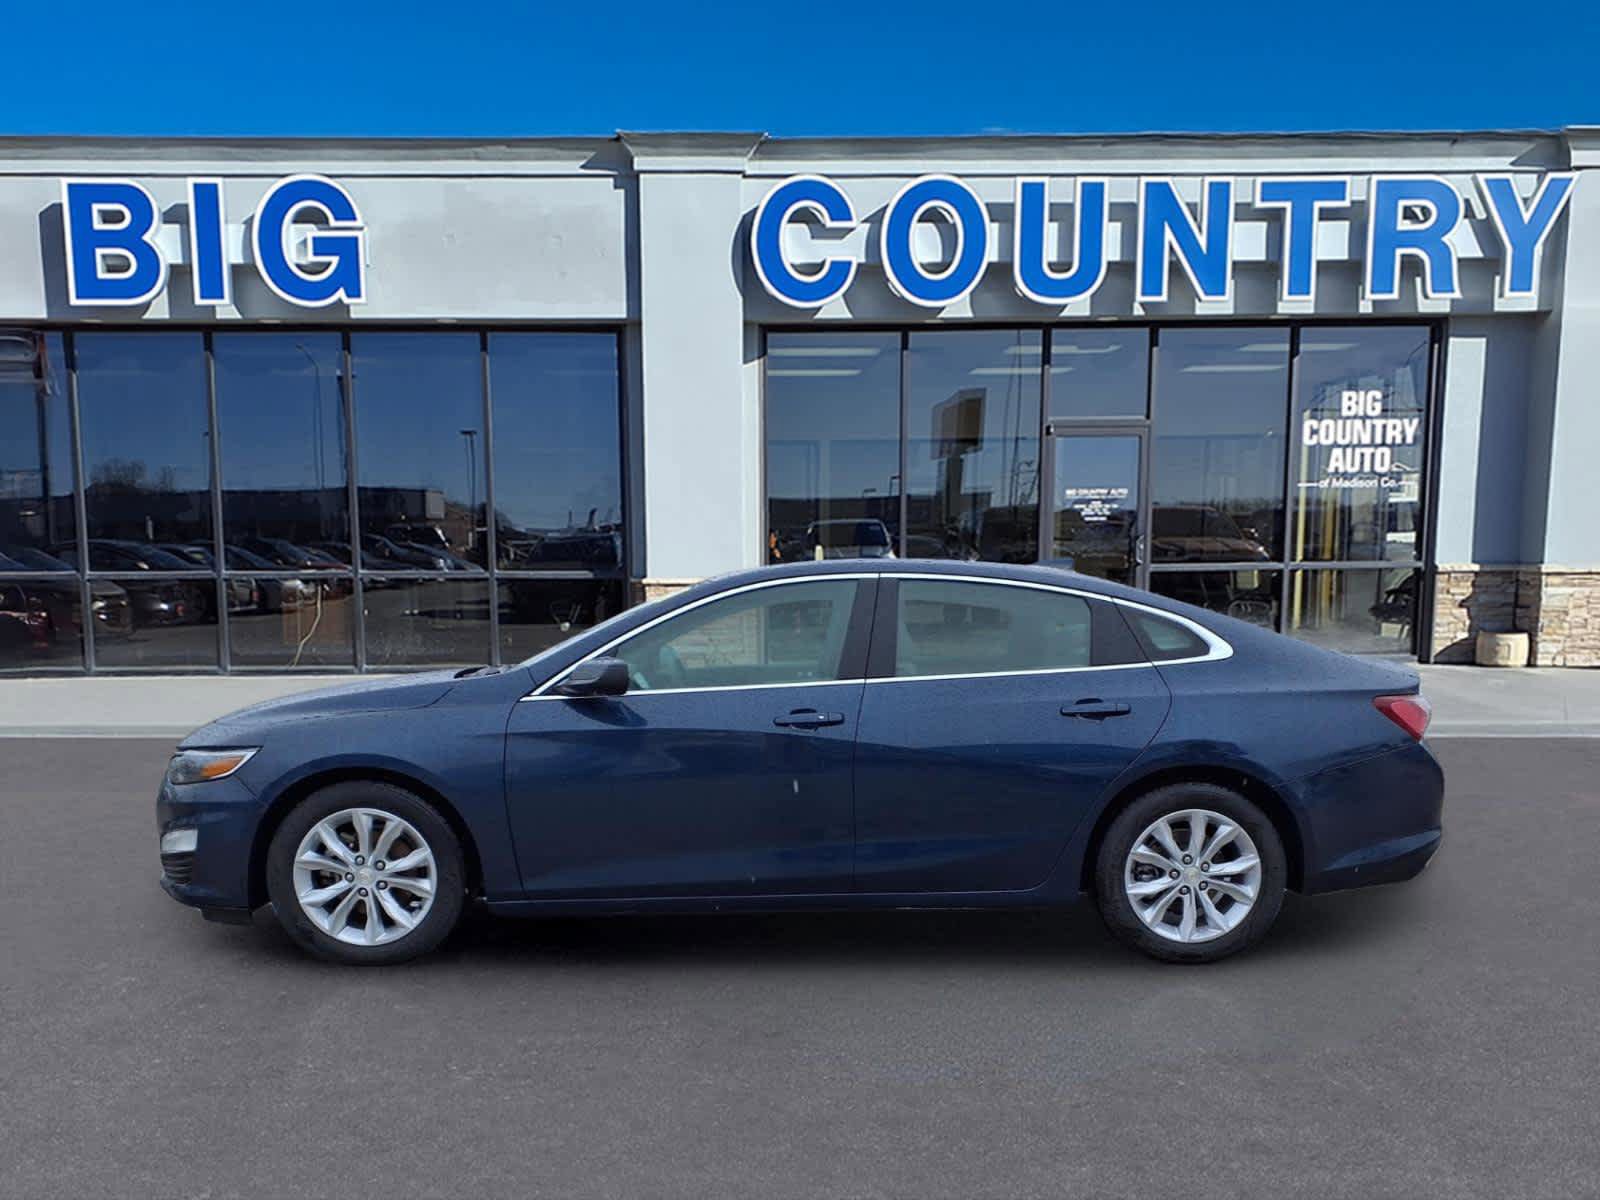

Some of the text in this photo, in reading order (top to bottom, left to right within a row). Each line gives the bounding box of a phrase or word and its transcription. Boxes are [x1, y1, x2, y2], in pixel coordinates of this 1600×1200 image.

[60, 173, 1577, 309] BIG COUNTRY
[1341, 390, 1383, 417] BIG
[1303, 418, 1420, 446] COUNTRY
[1327, 446, 1392, 474] AUTO
[1331, 477, 1379, 488] Madison
